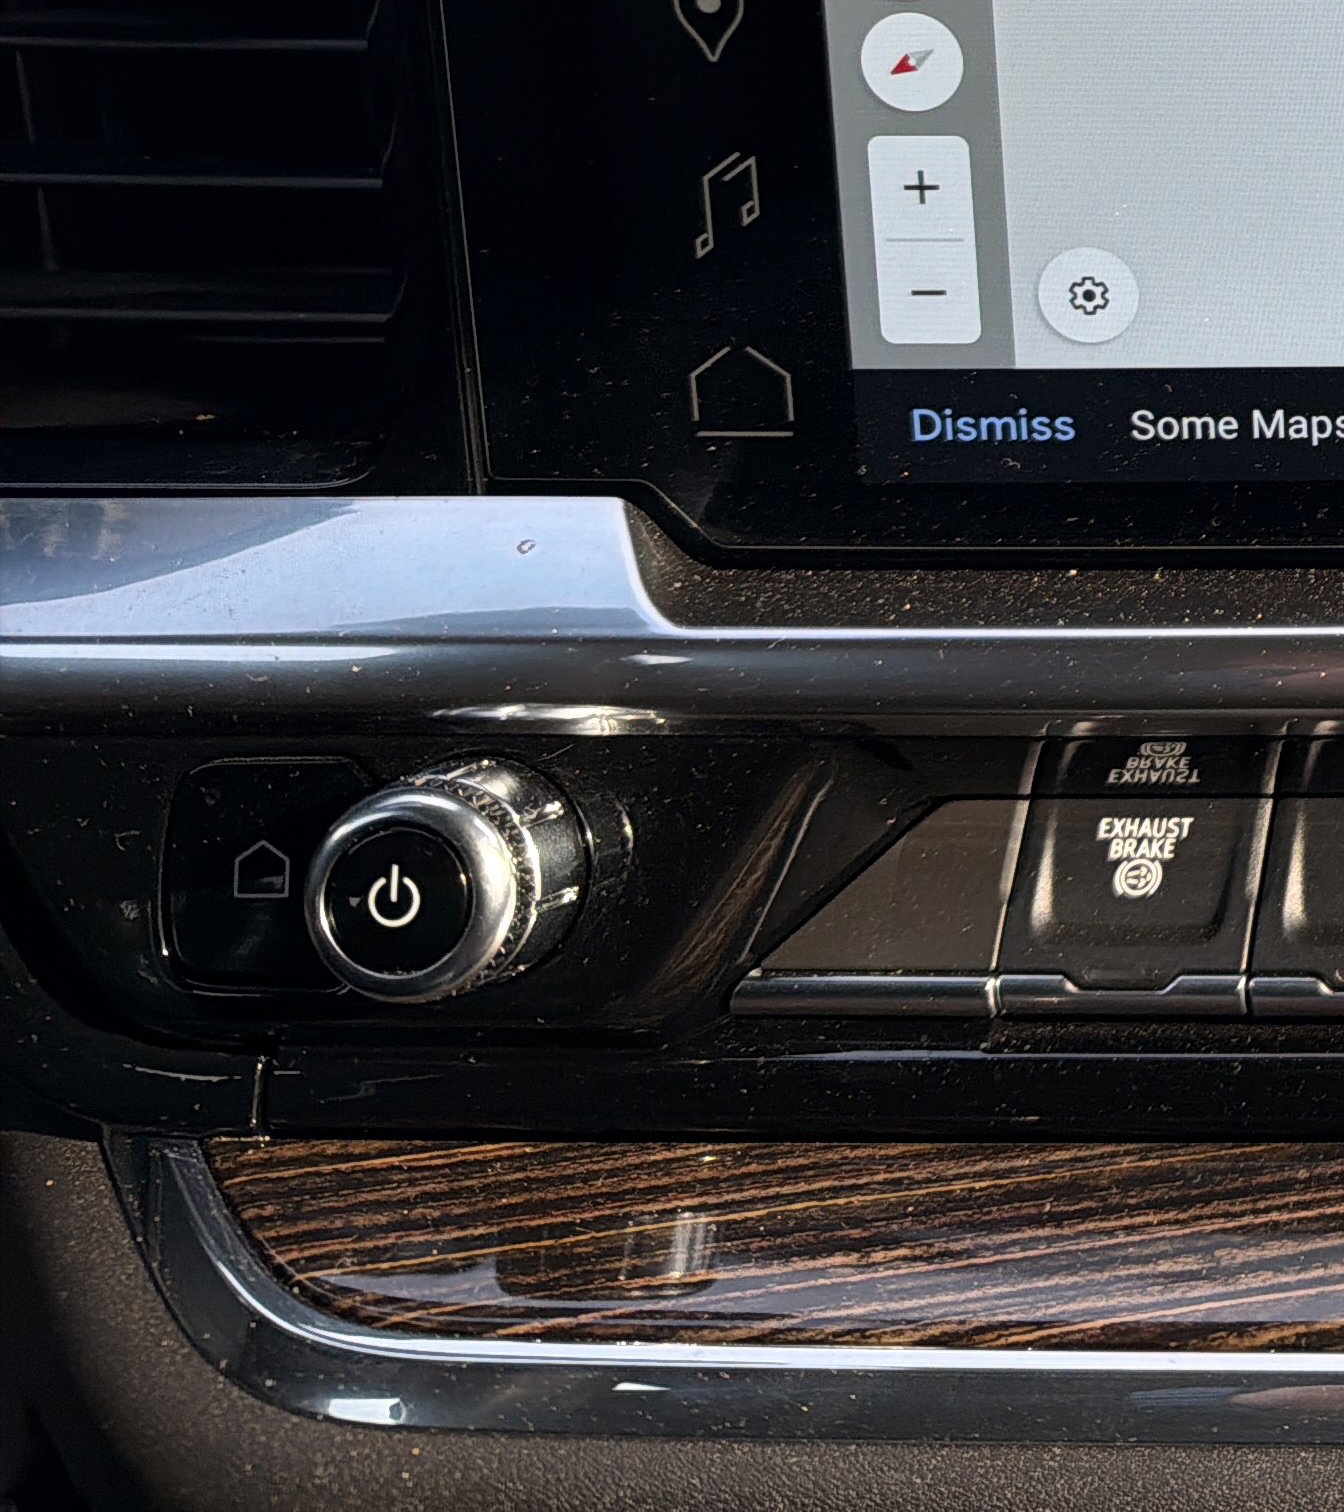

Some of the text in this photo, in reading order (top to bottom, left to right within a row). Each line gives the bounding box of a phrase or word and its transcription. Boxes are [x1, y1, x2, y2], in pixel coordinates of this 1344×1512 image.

[910, 406, 1077, 443] Dismiss
[1130, 408, 1240, 442] Some
[1096, 816, 1195, 841] EXHAUST
[1106, 838, 1178, 862] BRAKE
